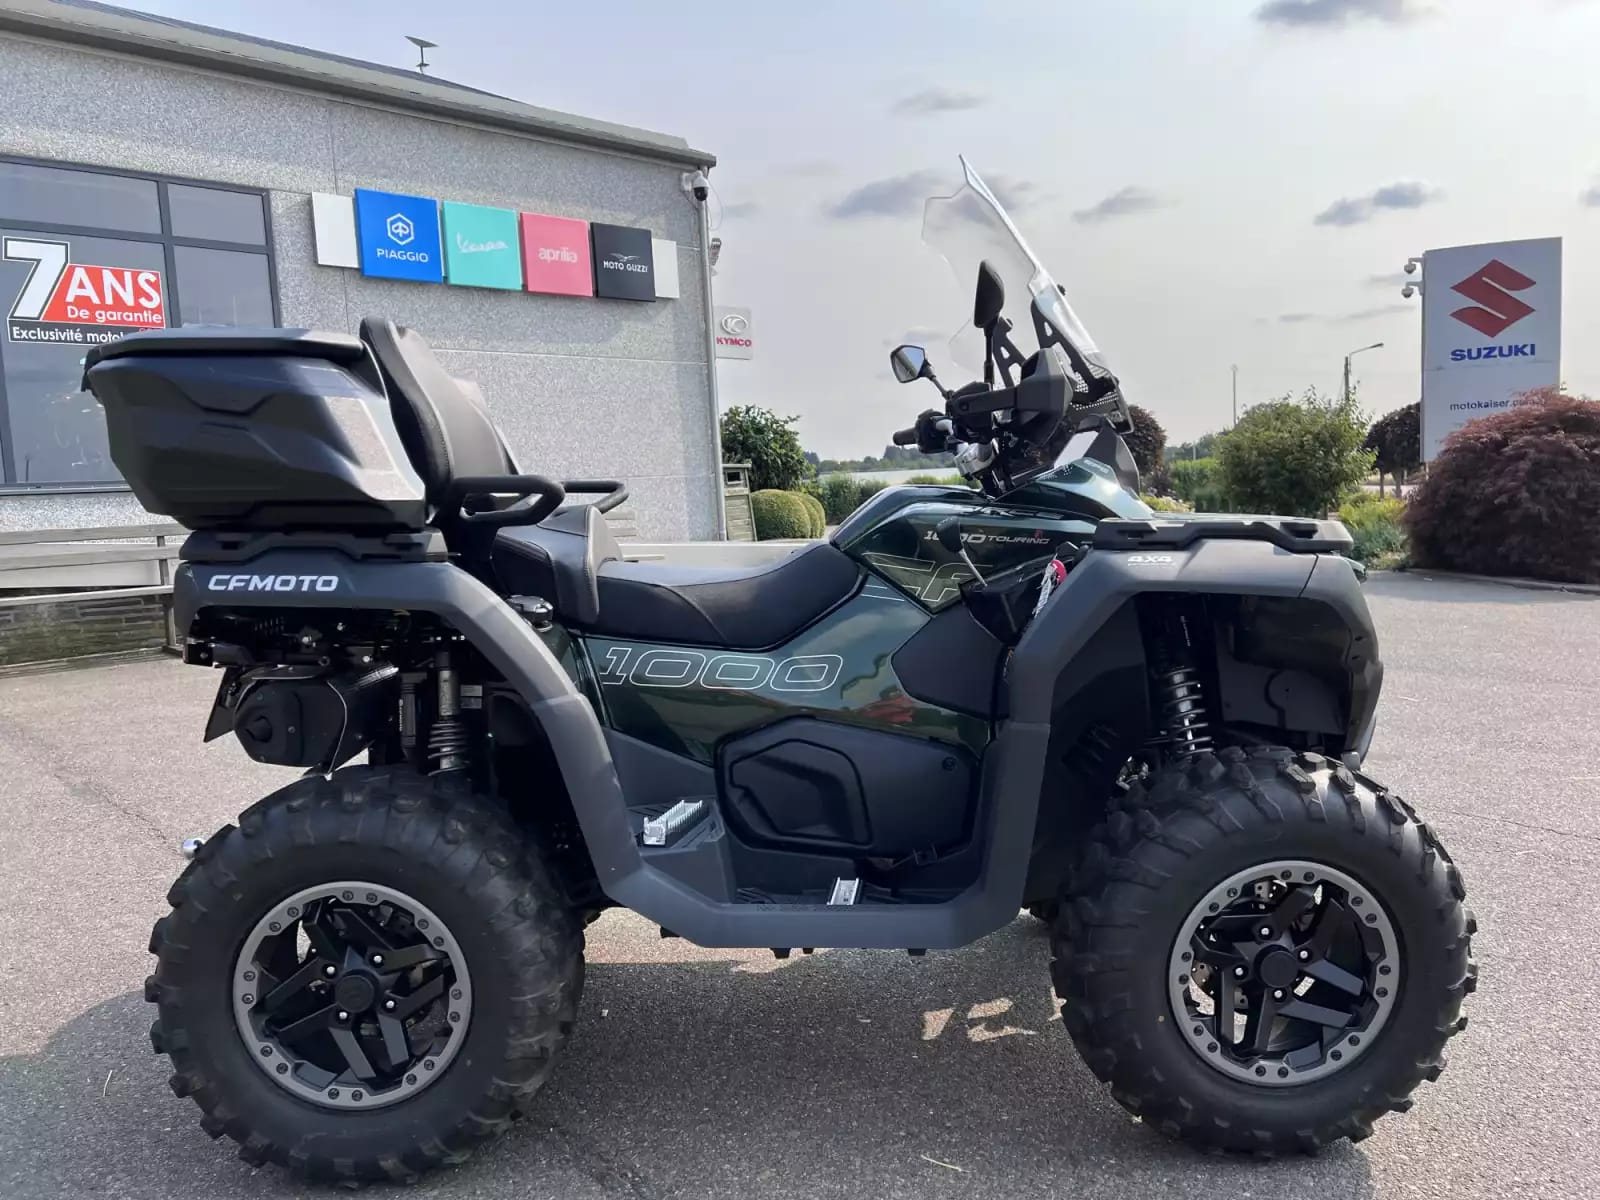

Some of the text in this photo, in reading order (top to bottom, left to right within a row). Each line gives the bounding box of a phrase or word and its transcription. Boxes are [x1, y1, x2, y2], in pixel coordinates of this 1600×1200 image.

[376, 248, 429, 263] PIAGGIO
[538, 246, 578, 263] aprilia
[603, 260, 649, 273] MOTO GUZZI
[3, 236, 161, 319] 7 ANS
[67, 305, 162, 323] De garantie
[12, 326, 83, 342] Exclusivité
[716, 336, 752, 347] KYMCO
[1450, 343, 1536, 362] SUZUKI
[988, 534, 1050, 545] TOURING
[207, 574, 339, 592] CFMOTO
[599, 647, 844, 692] 1000
